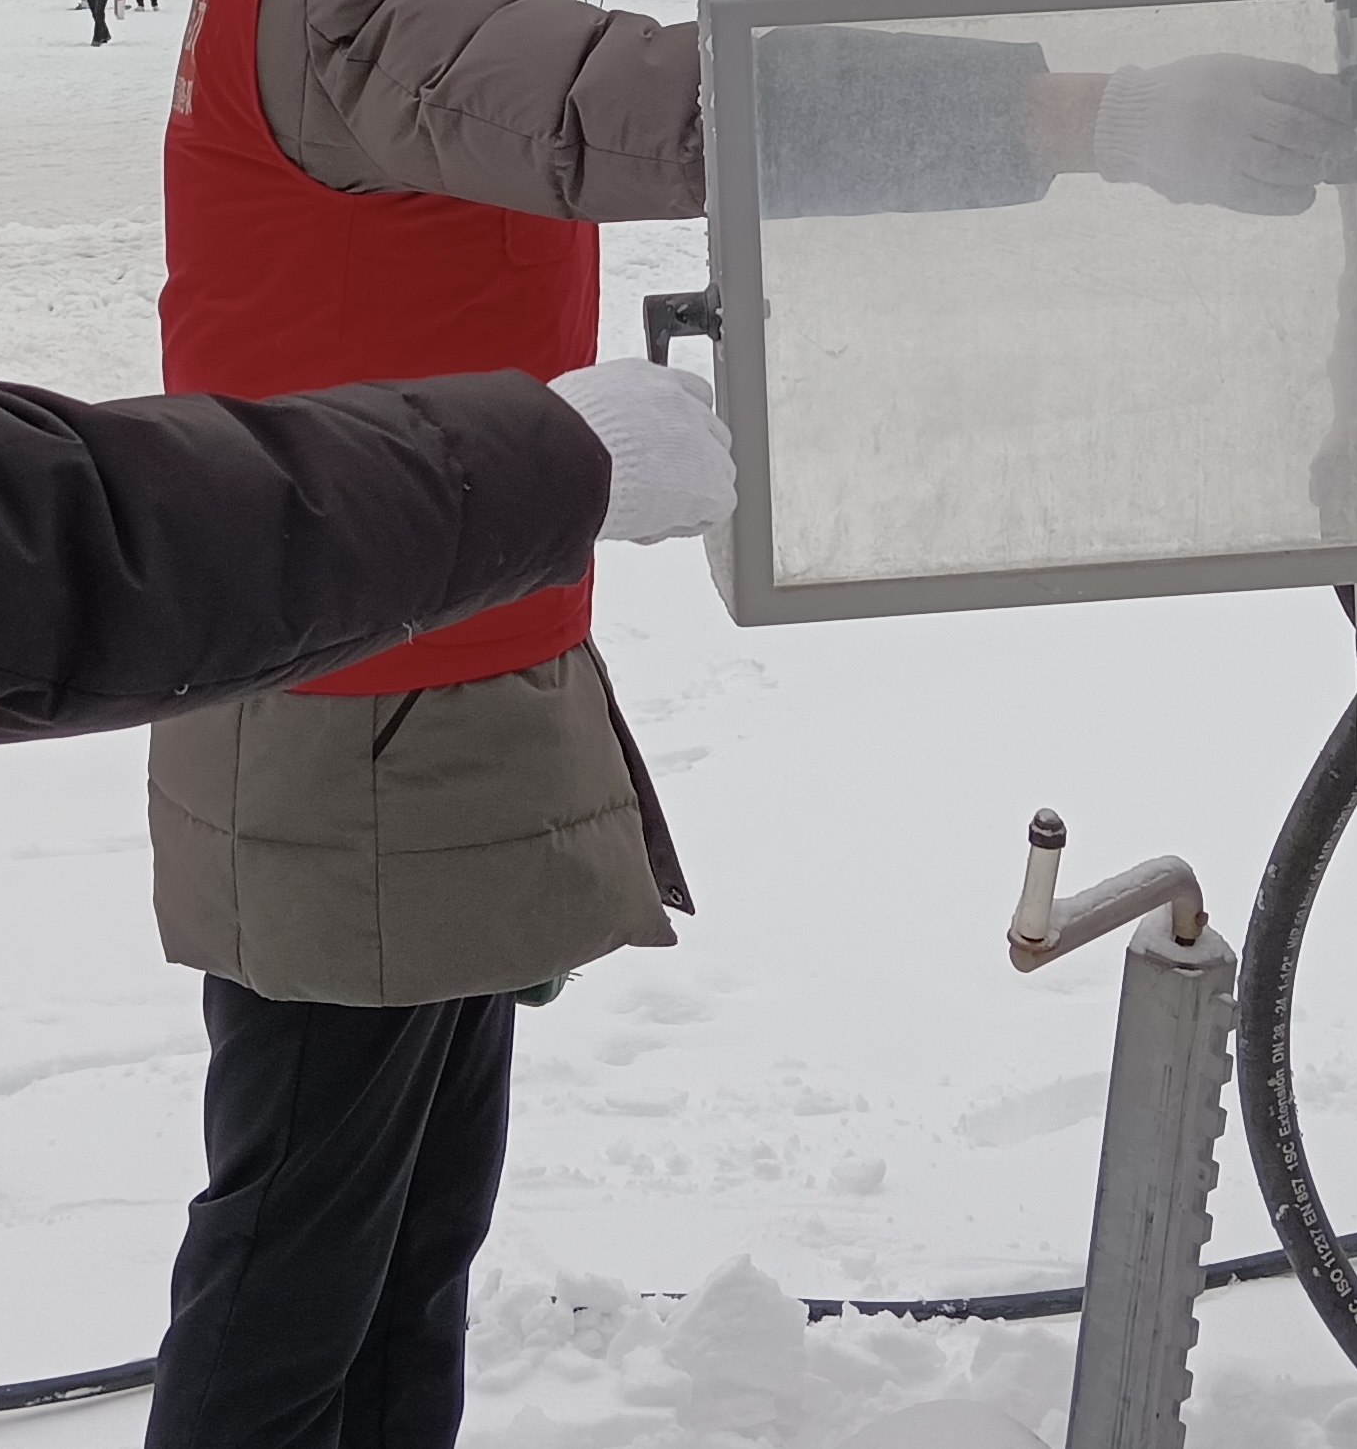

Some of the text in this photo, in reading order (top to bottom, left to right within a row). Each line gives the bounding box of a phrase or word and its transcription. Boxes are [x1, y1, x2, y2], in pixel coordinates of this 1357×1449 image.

[1273, 1023, 1285, 1040] 38
[1273, 1042, 1284, 1063] DN
[1282, 1142, 1298, 1170] 1SC
[1292, 1179, 1309, 1202] 857
[1300, 1203, 1317, 1226] EN
[1310, 1229, 1335, 1267] 11237
[1330, 1269, 1352, 1297] ISO
